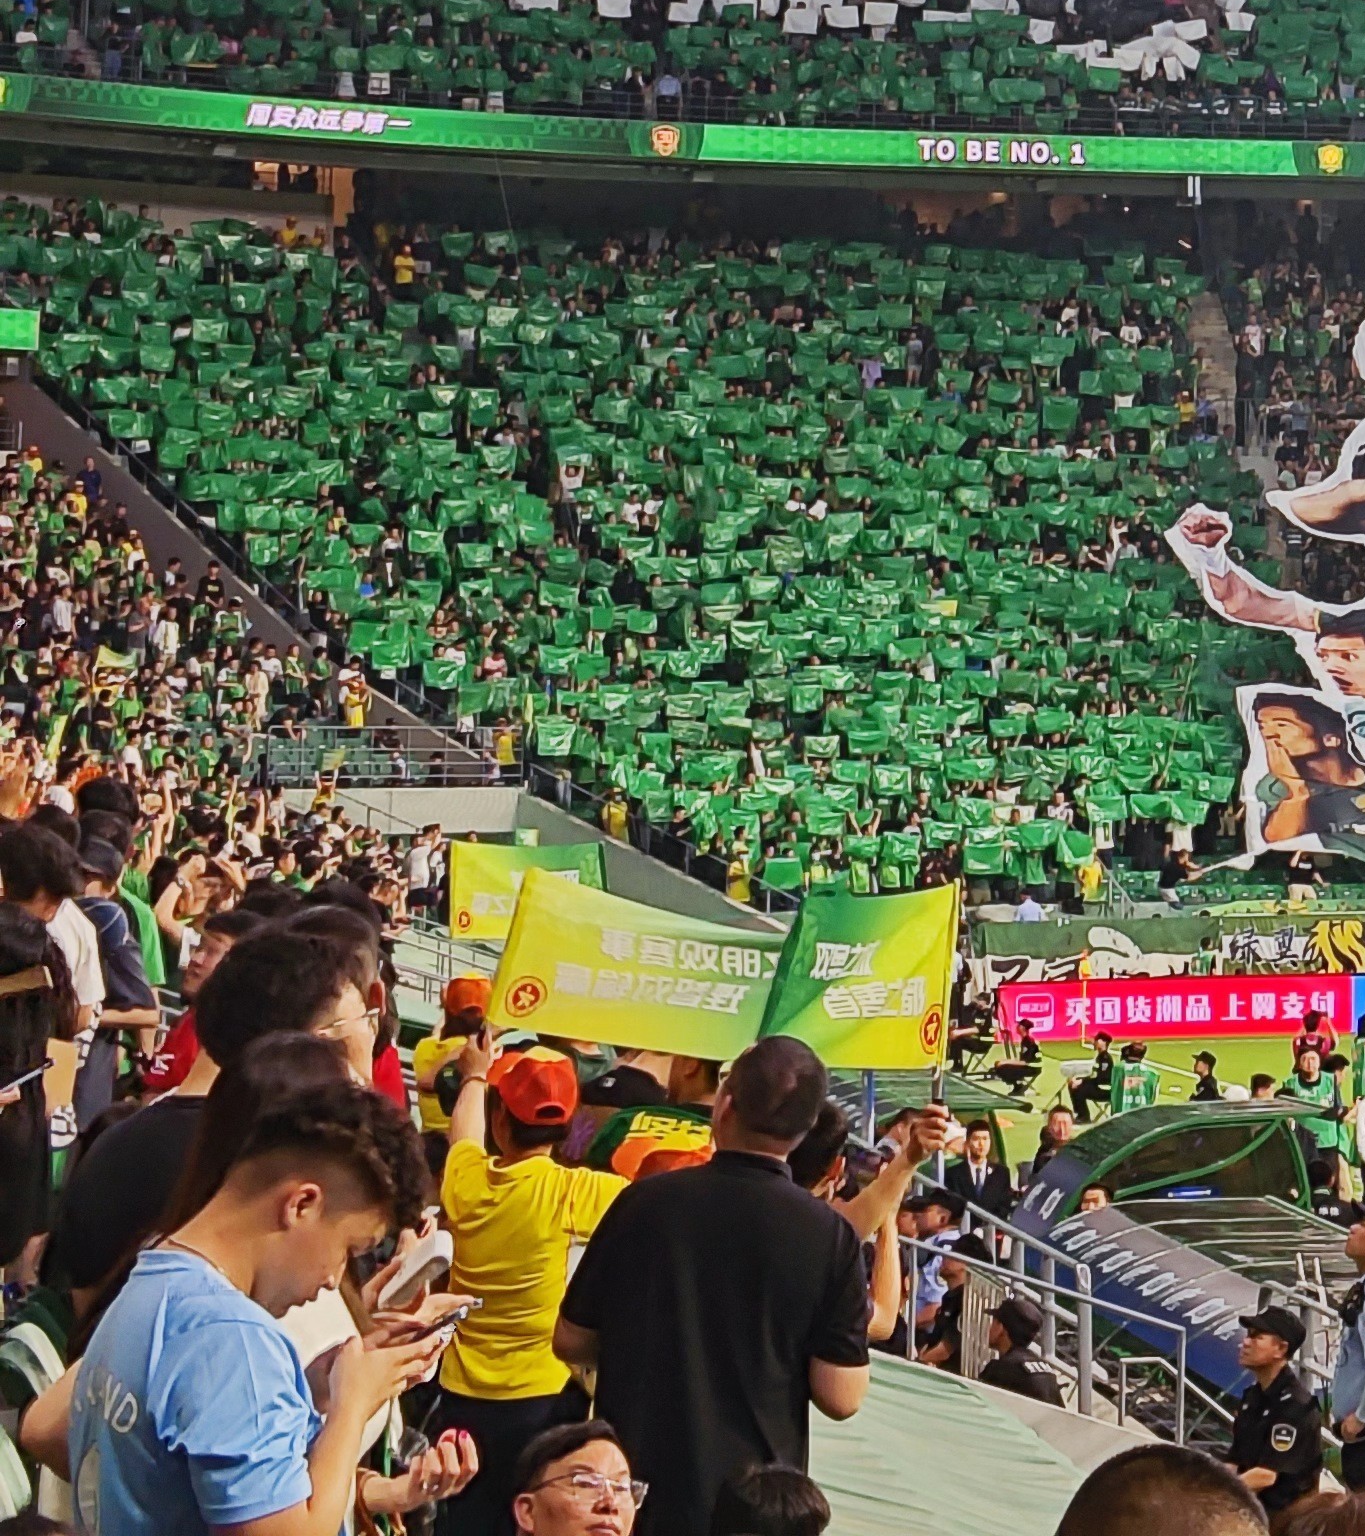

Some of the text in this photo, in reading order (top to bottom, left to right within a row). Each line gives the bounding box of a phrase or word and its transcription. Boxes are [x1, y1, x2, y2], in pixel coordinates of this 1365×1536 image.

[248, 102, 413, 134] 国安永远争第一
[918, 139, 1086, 165] TO BE NO. 1
[1065, 990, 1336, 1027] 买国货潮品 上翼支付
